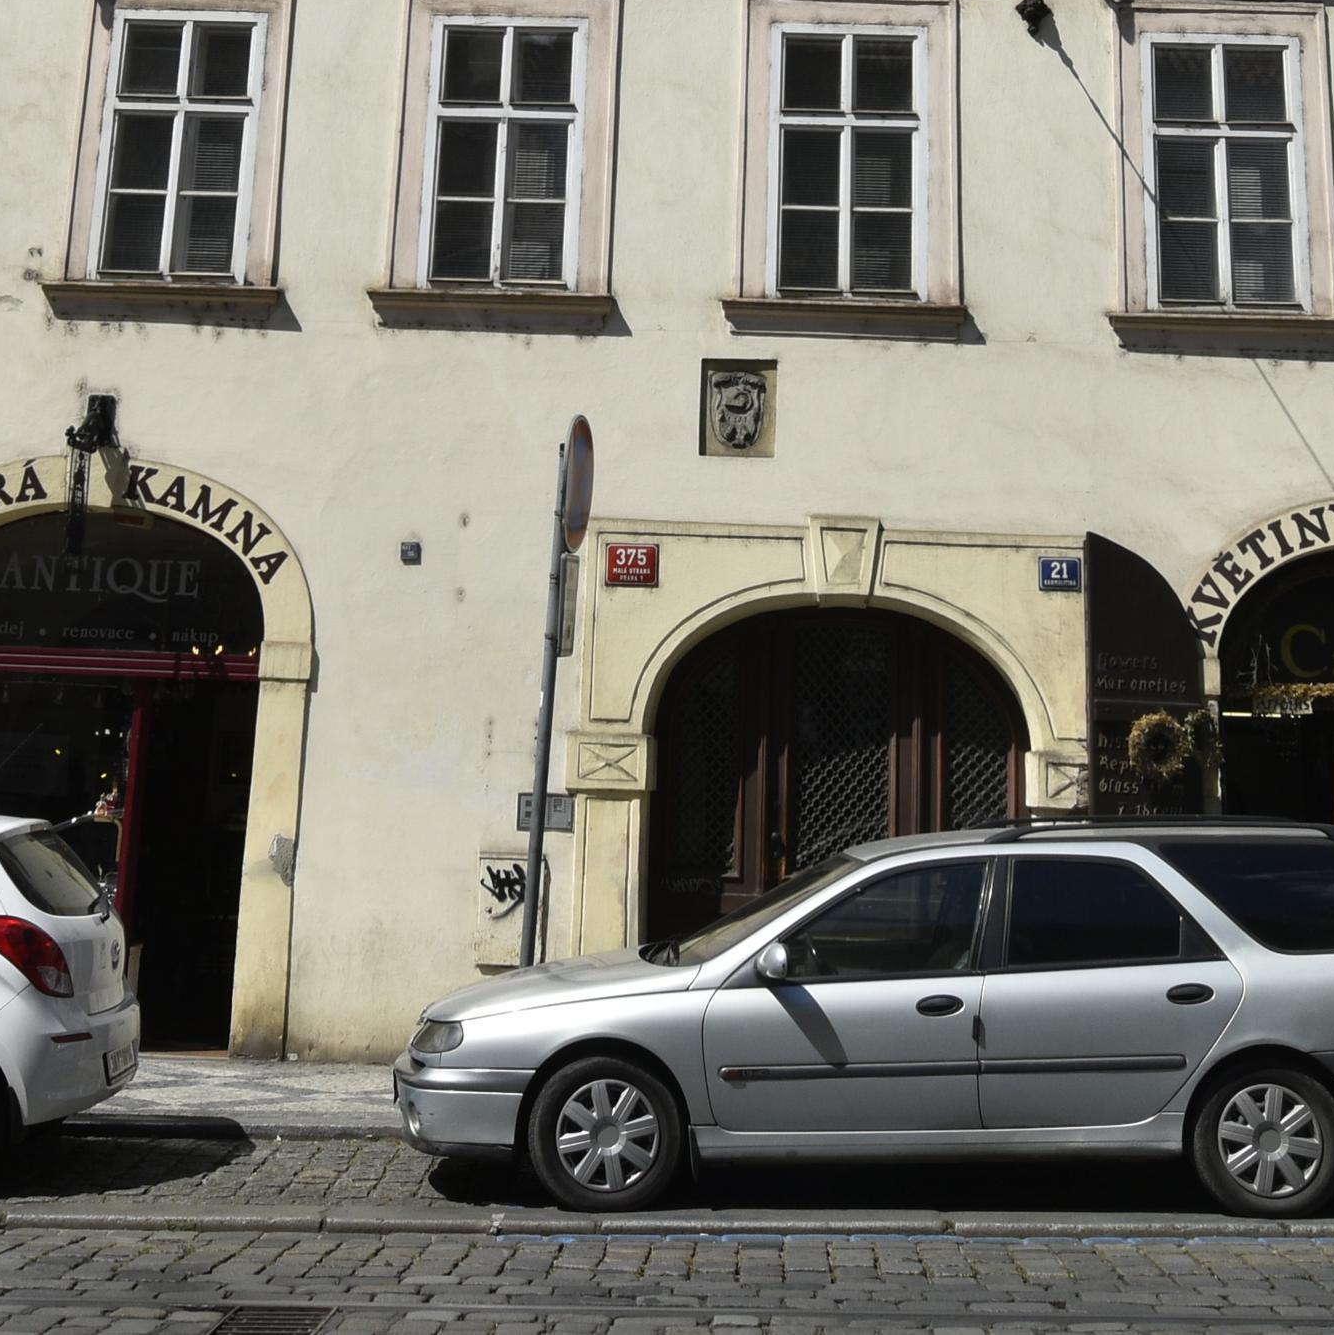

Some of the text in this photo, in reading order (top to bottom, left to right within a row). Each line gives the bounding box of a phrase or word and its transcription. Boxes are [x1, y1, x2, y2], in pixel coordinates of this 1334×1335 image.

[123, 464, 290, 585] KAMNA
[616, 548, 647, 566] 375
[613, 566, 627, 574] MALÁ
[1050, 561, 1068, 579] 21
[62, 625, 135, 642] renovace
[171, 626, 220, 646] nákup
